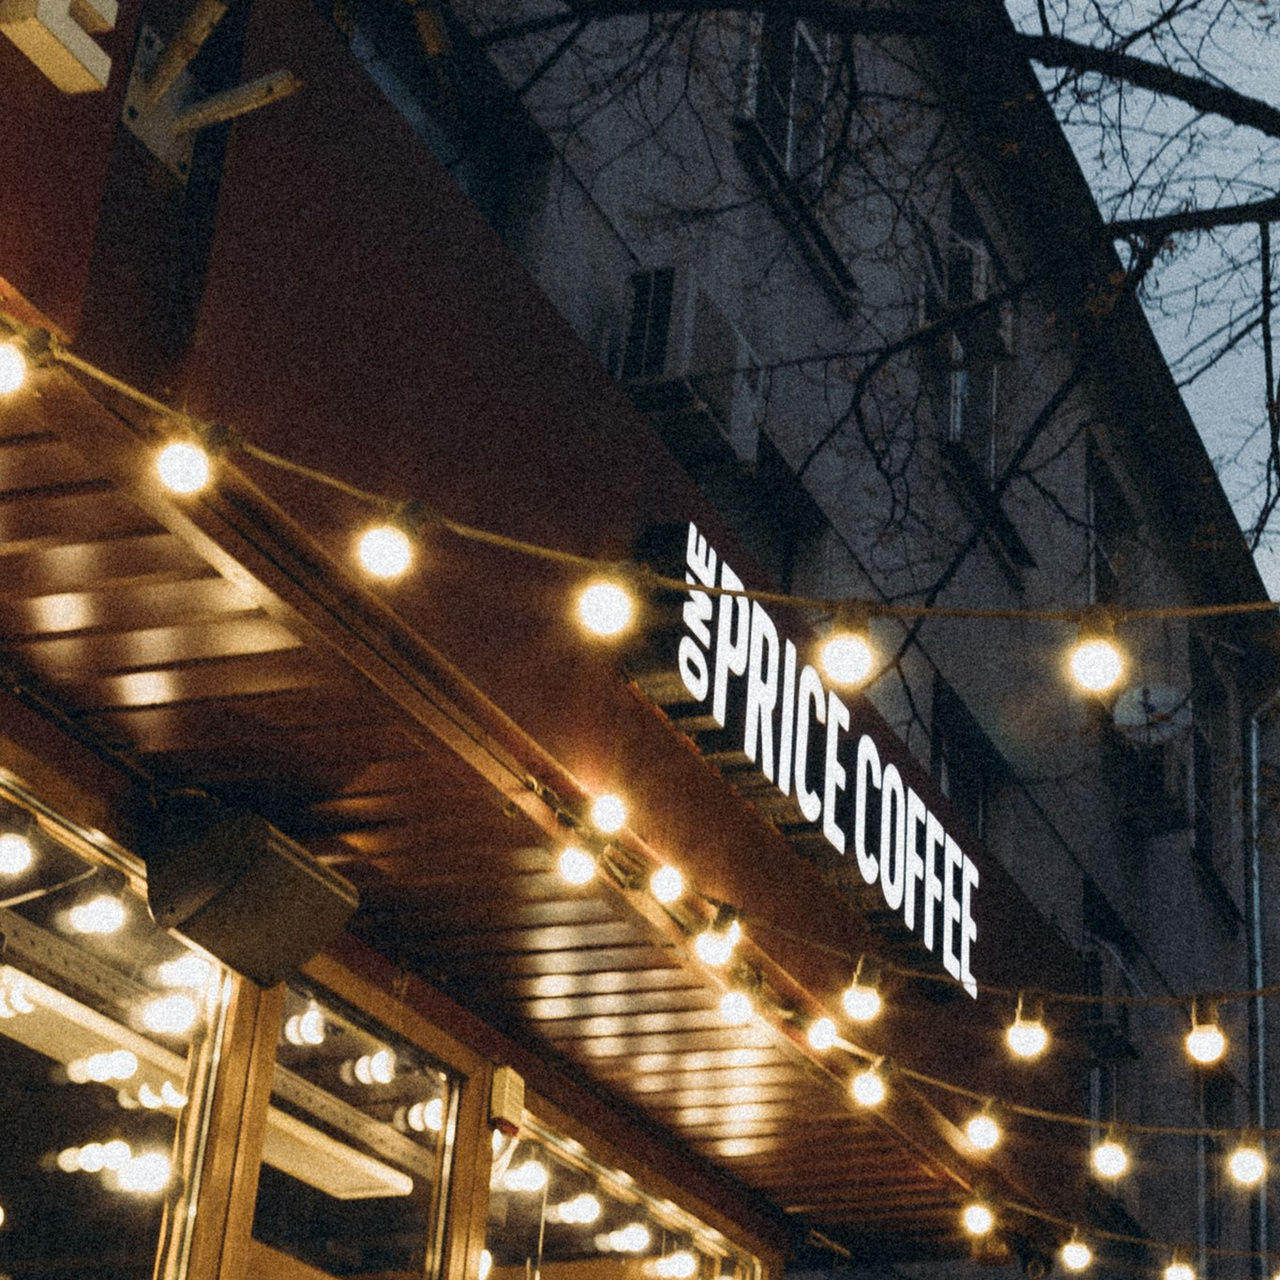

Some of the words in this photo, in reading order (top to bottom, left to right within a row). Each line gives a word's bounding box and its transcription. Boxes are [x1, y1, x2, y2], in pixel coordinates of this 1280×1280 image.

[678, 521, 717, 701] ONE
[713, 561, 850, 855] PRICE
[855, 734, 979, 1000] COFFEE
